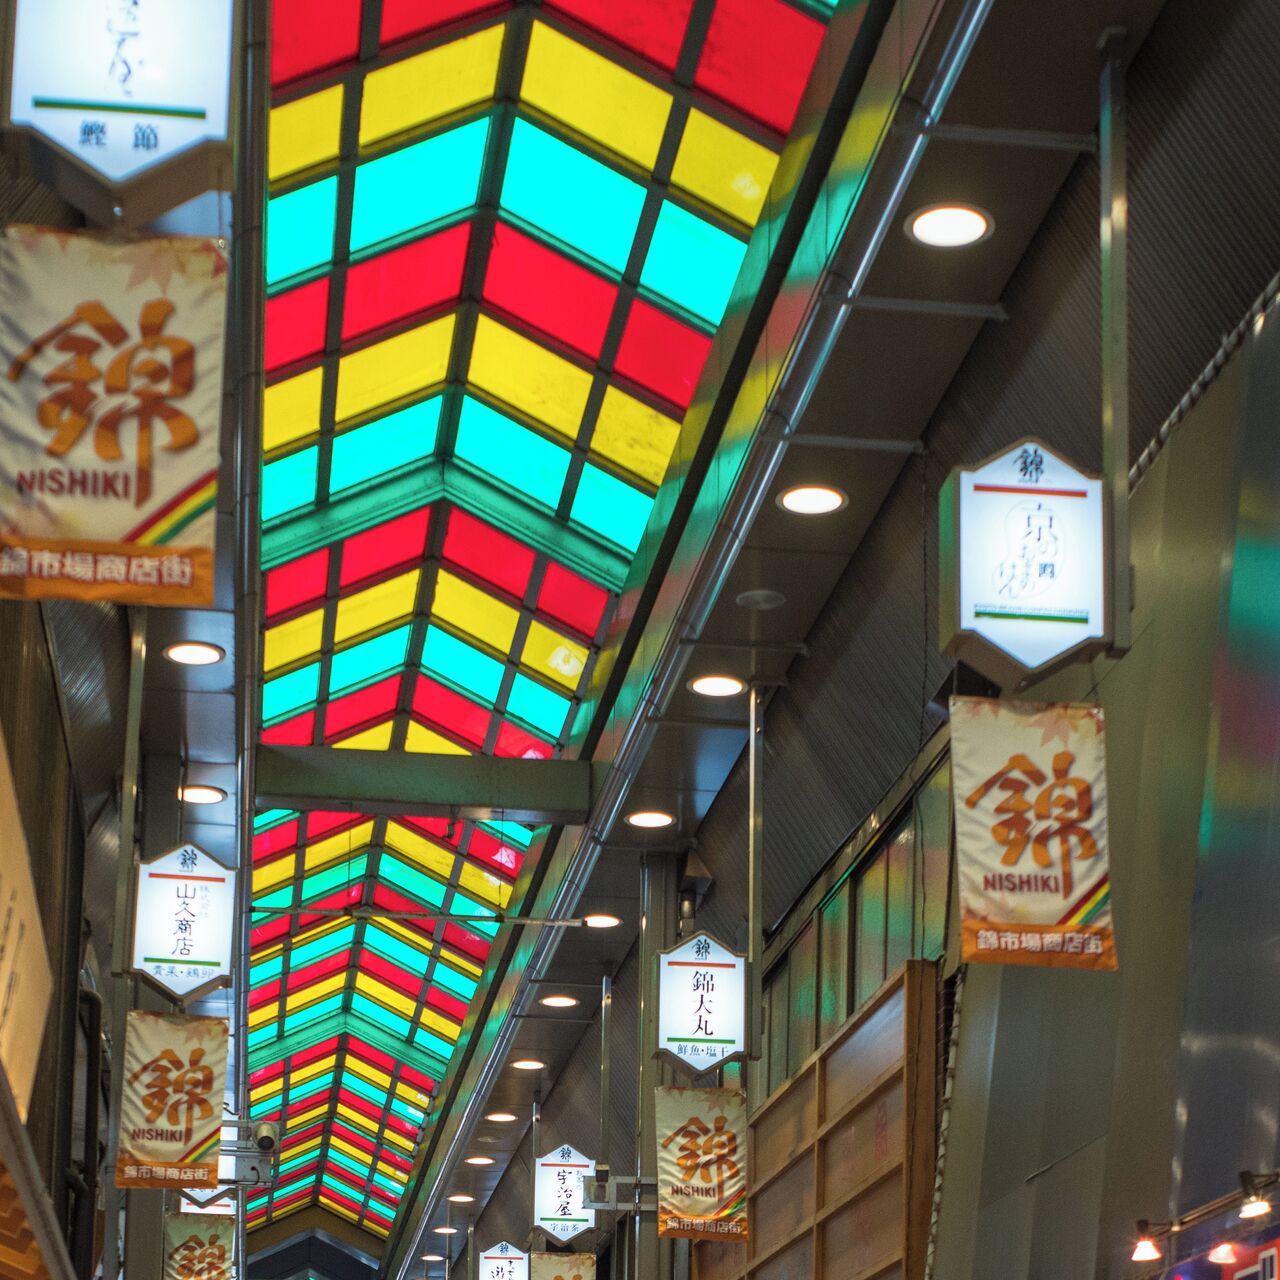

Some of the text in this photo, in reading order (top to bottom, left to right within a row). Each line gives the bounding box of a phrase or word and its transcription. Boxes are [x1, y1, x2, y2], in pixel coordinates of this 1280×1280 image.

[7, 298, 199, 508] 錦
[1013, 447, 1045, 483] 錦
[16, 468, 131, 500] NISHIKI
[966, 751, 1099, 899] 錦
[984, 872, 1060, 893] NISHIKI
[172, 884, 197, 956] 山久商店
[692, 939, 711, 961] 錦
[977, 929, 1103, 955] 錦市場商店街
[692, 970, 715, 1036] 錦大丸
[128, 1048, 214, 1145] 錦
[132, 1128, 183, 1143] NISHIKI
[124, 1164, 209, 1181] 錦市場商店街
[662, 1116, 741, 1201] 錦
[555, 1169, 573, 1216] 宇治屋
[671, 1186, 715, 1198] NISHIKI
[666, 1218, 741, 1235] 錦市場商店街
